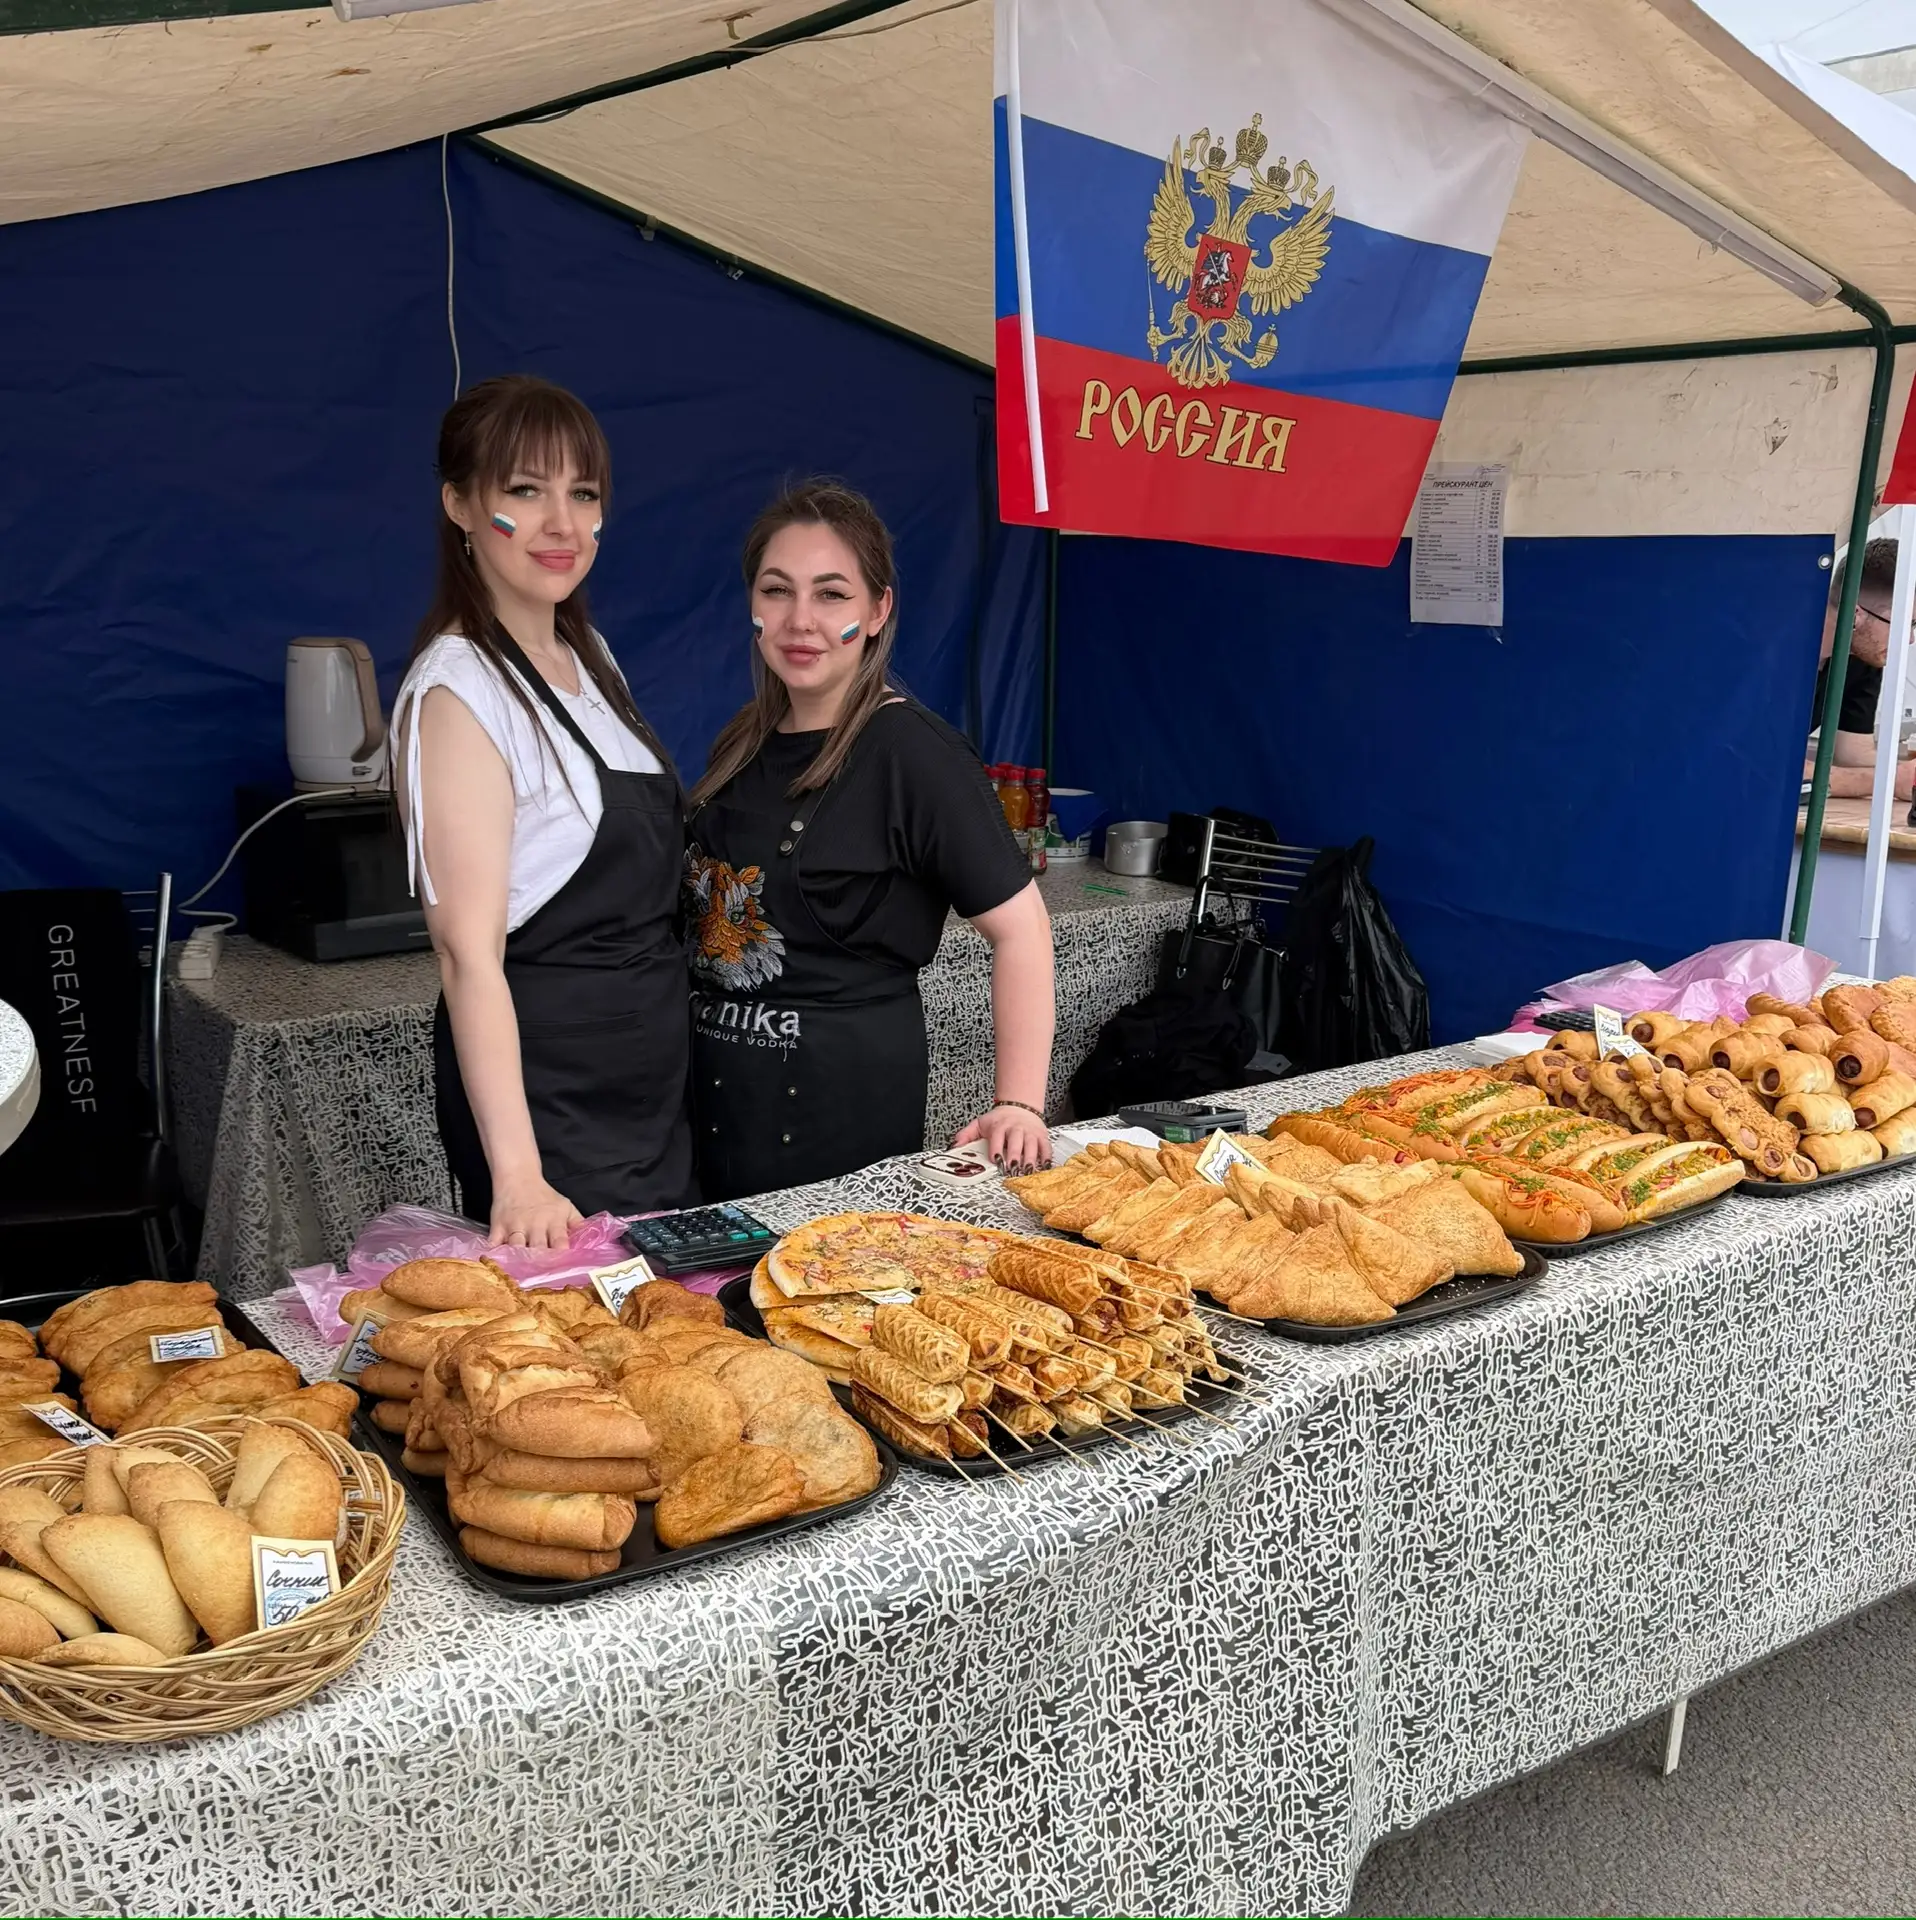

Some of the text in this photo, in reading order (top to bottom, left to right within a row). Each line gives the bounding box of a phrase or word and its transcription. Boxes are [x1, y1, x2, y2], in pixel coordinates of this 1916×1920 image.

[1075, 379, 1297, 473] РОССИЯ
[1432, 480, 1494, 489] ПРЕЙСКУРАНТ ЦЕН
[696, 1024, 798, 1049] UNIQUE VODKA
